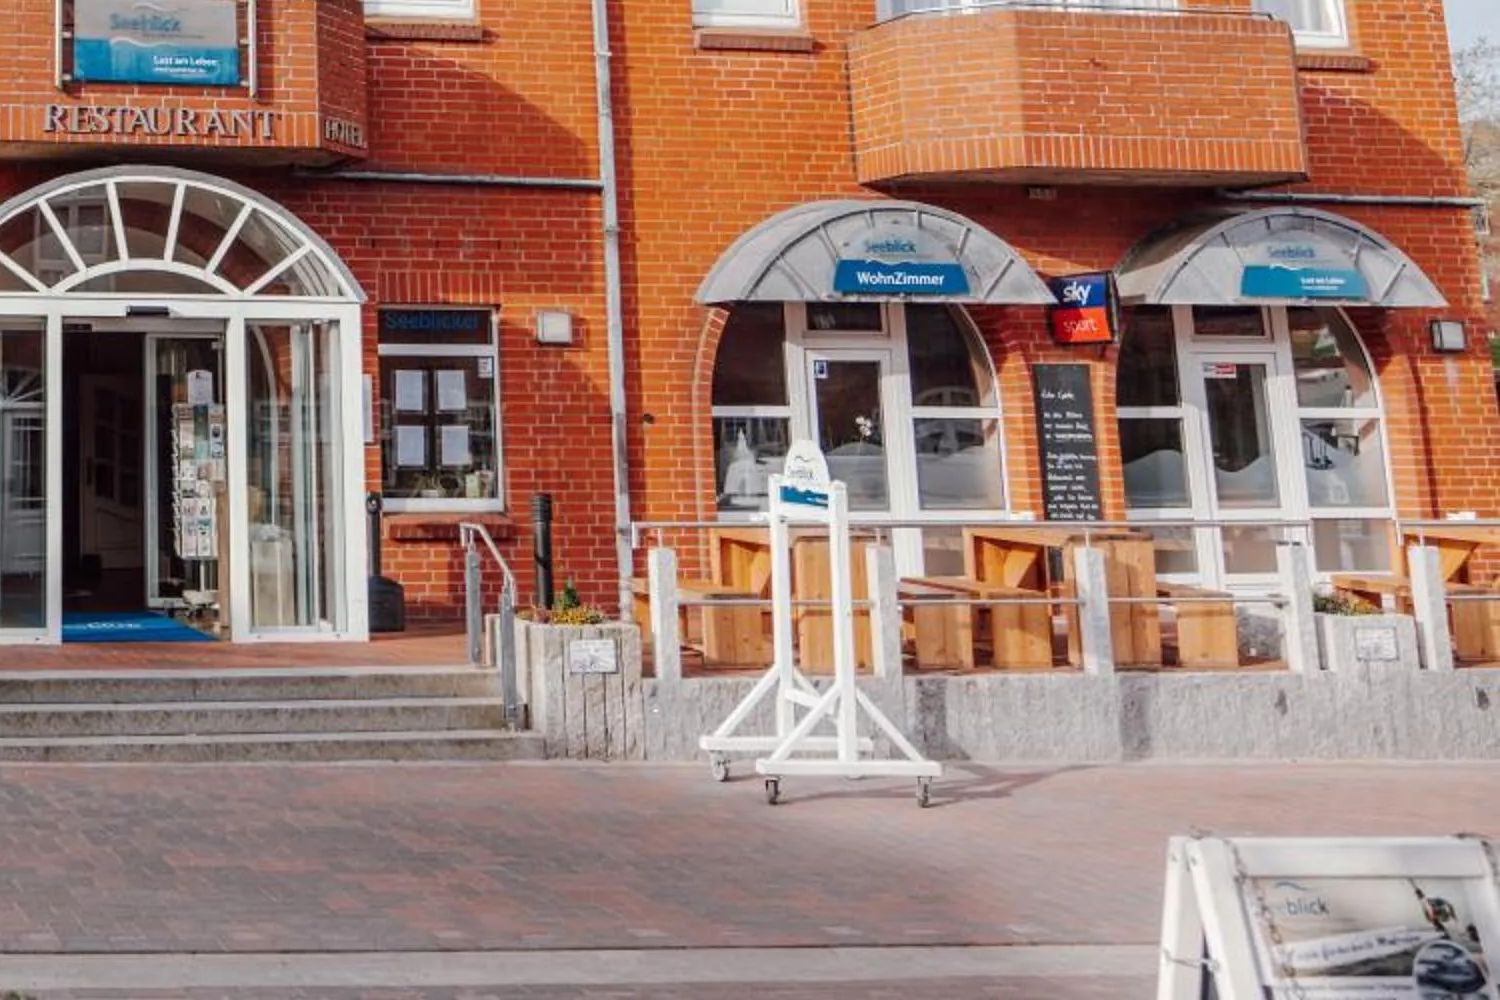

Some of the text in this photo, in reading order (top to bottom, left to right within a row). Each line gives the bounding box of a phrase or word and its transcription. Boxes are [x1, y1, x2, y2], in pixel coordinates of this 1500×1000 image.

[43, 103, 276, 140] RESTAURANT
[324, 118, 368, 148] HOTEL
[856, 271, 945, 286] WohnZimmer
[1063, 281, 1091, 306] sky
[1063, 317, 1098, 337] sport
